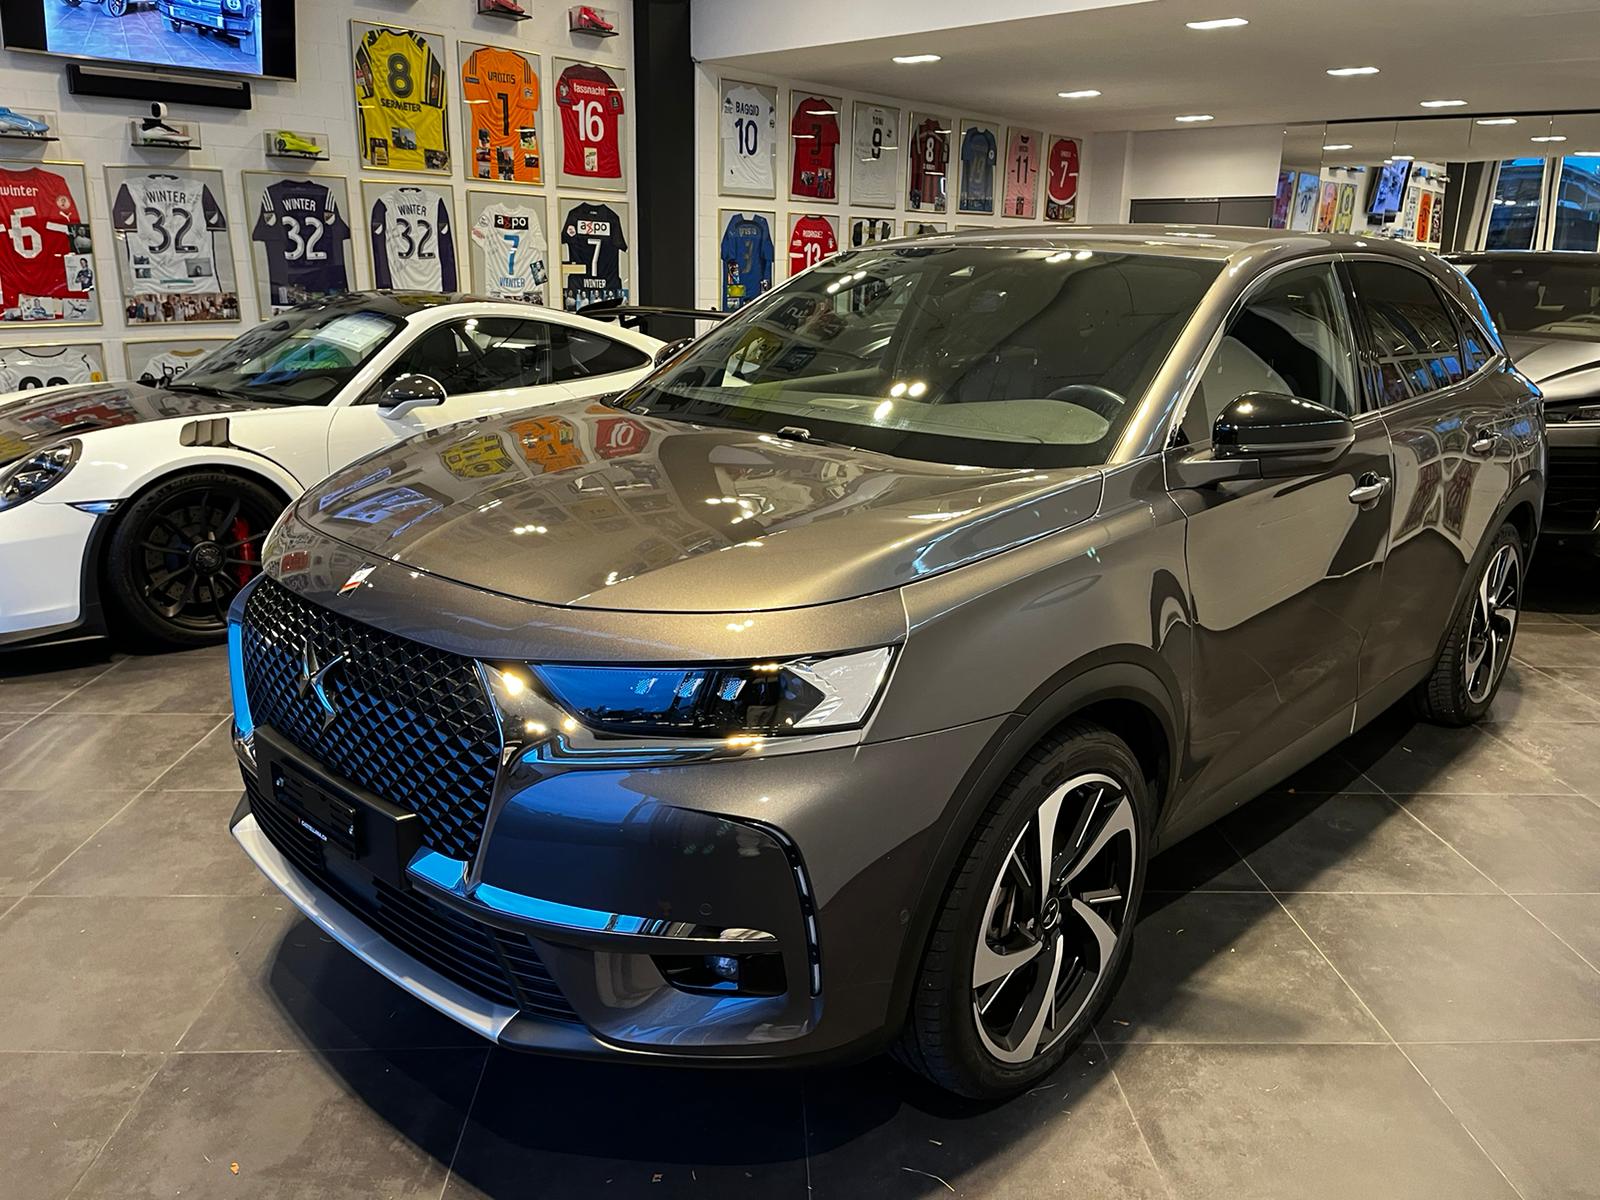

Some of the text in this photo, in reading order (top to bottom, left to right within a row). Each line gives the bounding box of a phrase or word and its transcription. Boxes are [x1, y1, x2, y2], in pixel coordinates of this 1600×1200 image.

[387, 53, 414, 98] 8
[497, 93, 509, 136] 1
[572, 100, 605, 142] 16
[735, 101, 760, 116] BAGGIO
[735, 118, 758, 156] 10
[925, 137, 935, 163] 8
[1016, 155, 1028, 184] 11
[1060, 161, 1069, 188] 7
[0, 184, 39, 196] winter
[145, 189, 186, 204] WINTER
[282, 198, 317, 212] WINTER
[397, 204, 427, 217] WINTER
[7, 206, 43, 259] 6
[144, 207, 199, 254] 32
[281, 216, 328, 261] 32
[396, 218, 436, 260] 32
[503, 234, 520, 275] 7
[587, 238, 602, 277] 7
[499, 276, 526, 288] WINTER
[583, 279, 607, 289] WINTER
